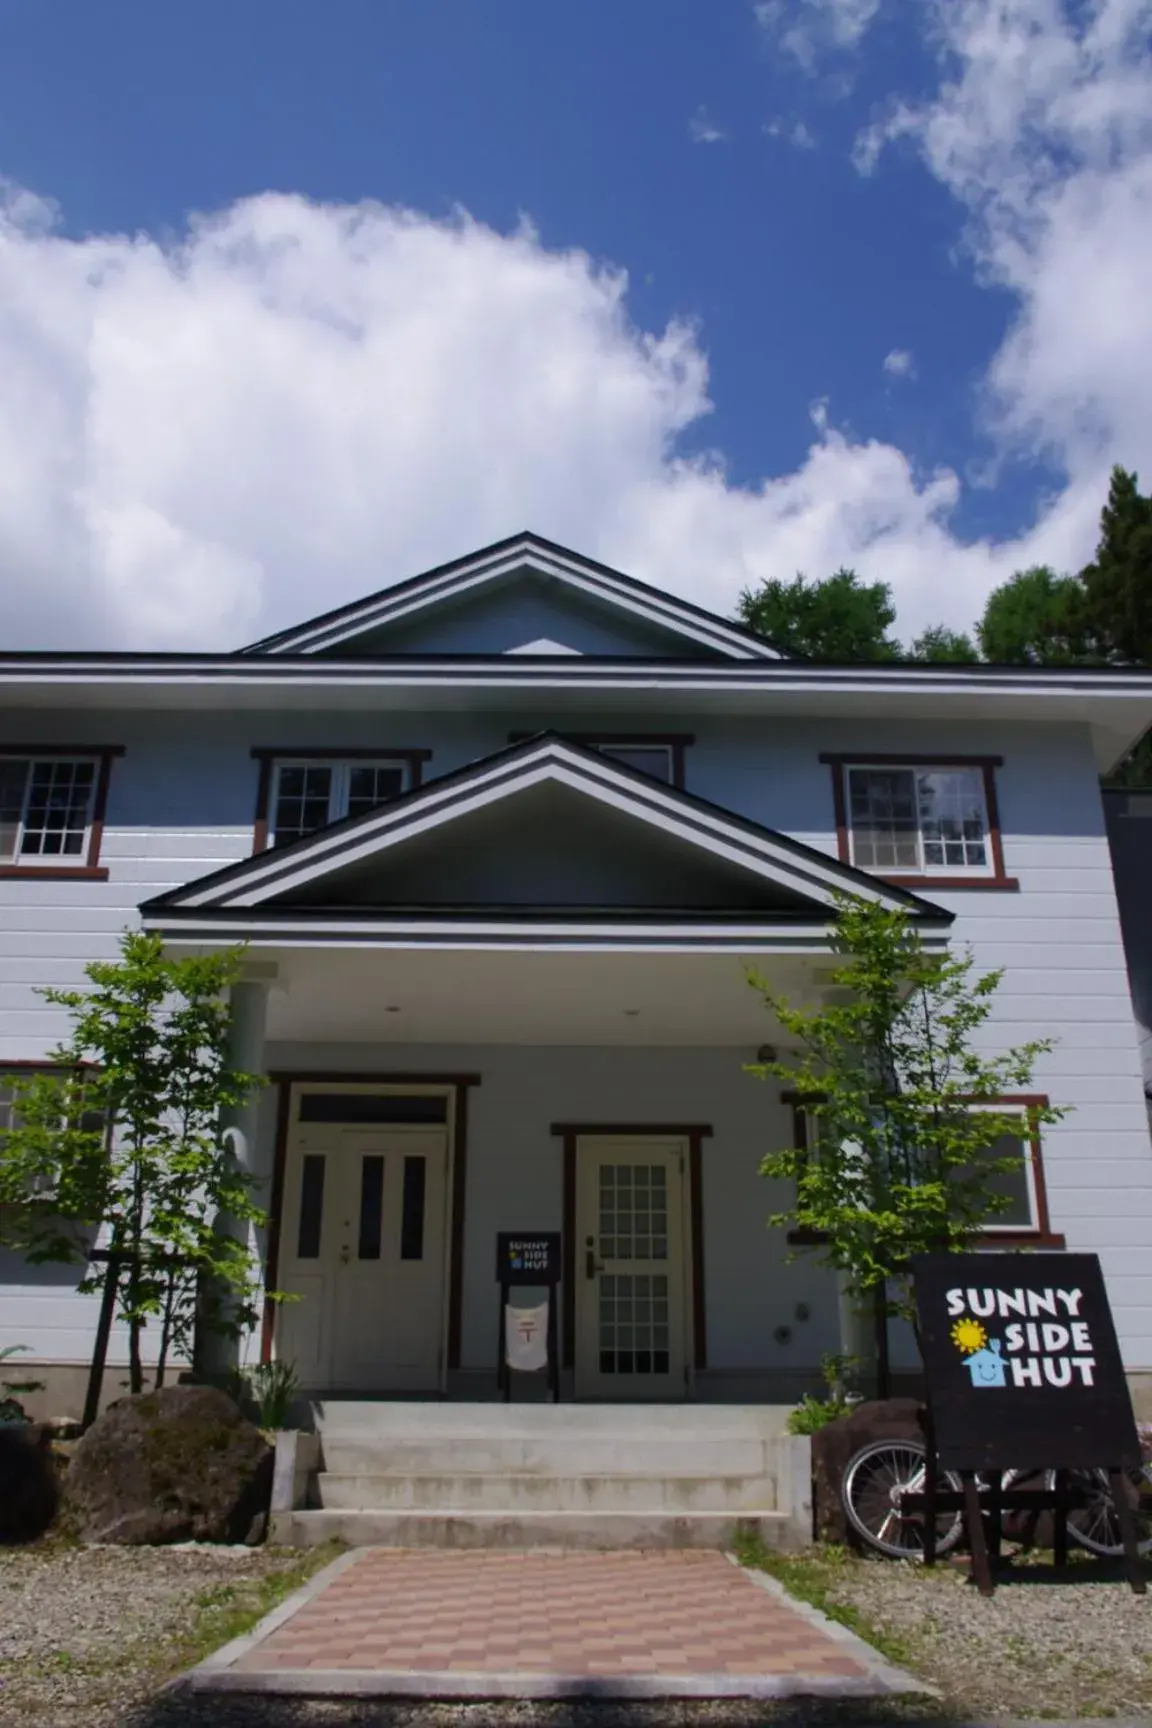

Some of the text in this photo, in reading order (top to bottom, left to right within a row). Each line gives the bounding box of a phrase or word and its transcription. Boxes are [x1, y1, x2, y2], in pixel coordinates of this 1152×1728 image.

[509, 1242, 549, 1250] SUNNY
[524, 1251, 548, 1260] SIDE
[524, 1260, 548, 1269] HUT
[945, 1288, 1083, 1317] SUNNY
[1005, 1322, 1093, 1352] SIDE
[1010, 1357, 1096, 1387] HUT
